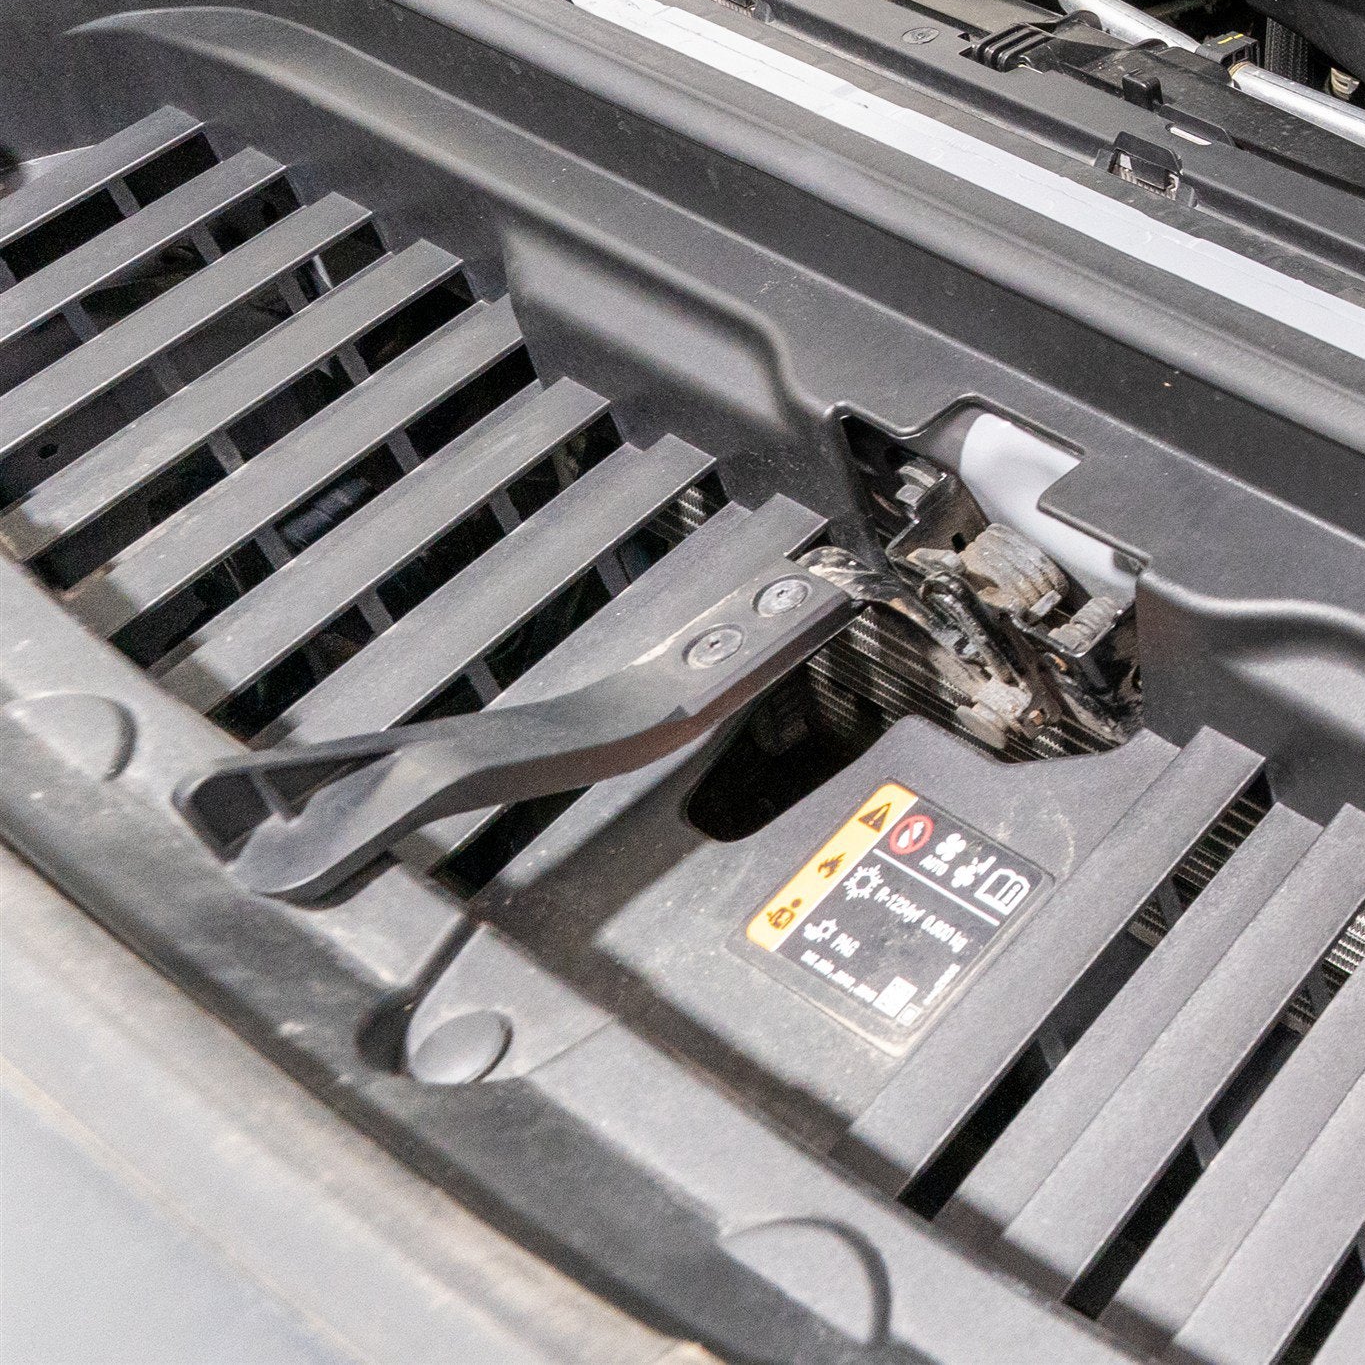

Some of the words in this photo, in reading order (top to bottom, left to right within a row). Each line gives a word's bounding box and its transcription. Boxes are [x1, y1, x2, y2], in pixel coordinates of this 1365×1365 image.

[919, 854, 949, 876] AUTO
[830, 933, 860, 958] PAG
[948, 931, 969, 953] kg
